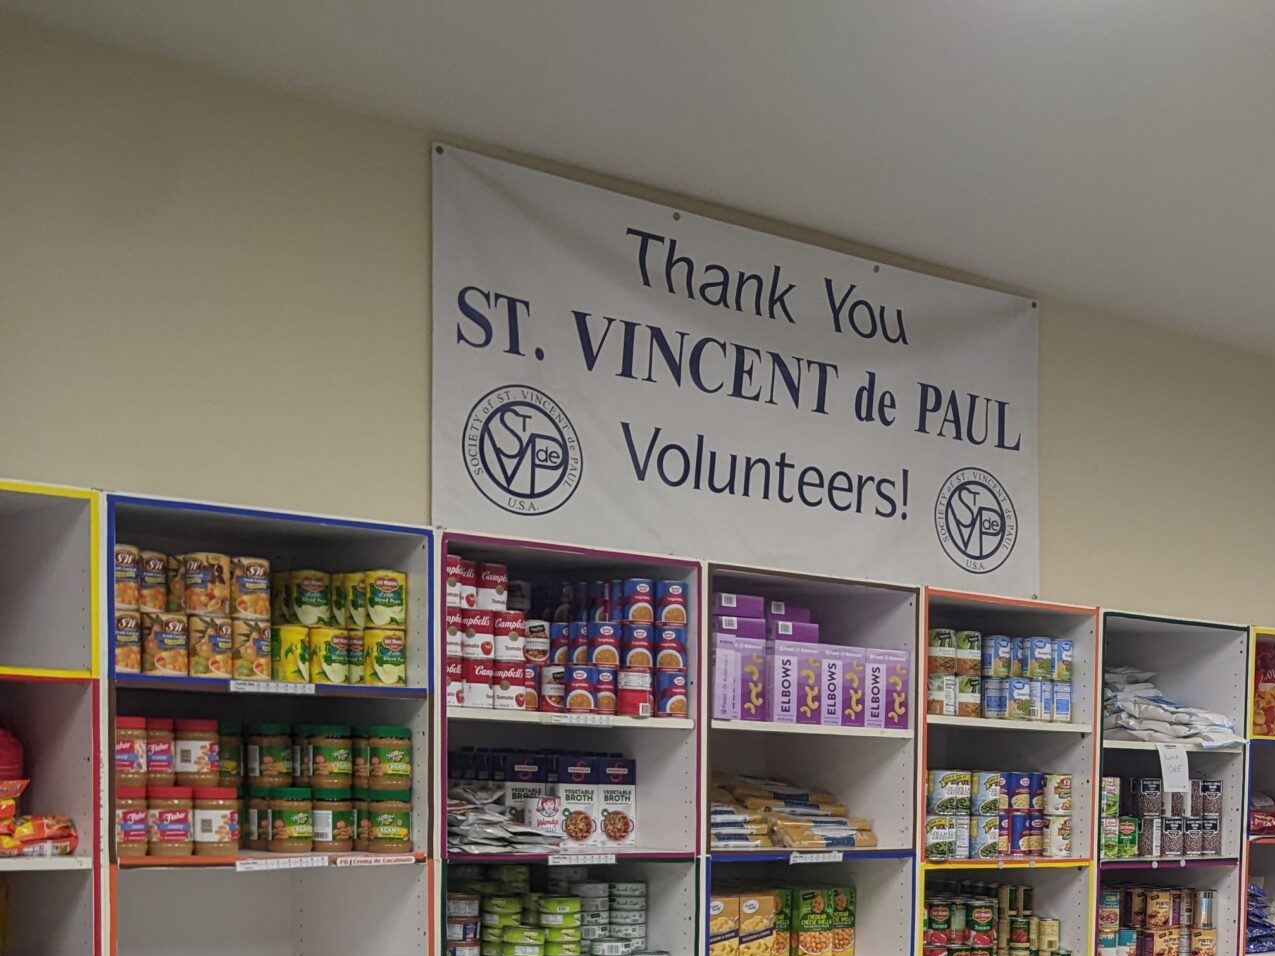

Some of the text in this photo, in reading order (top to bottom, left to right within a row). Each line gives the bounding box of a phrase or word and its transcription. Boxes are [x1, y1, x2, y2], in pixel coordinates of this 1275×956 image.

[626, 227, 909, 346] Thank You
[456, 285, 1022, 452] ST. VINCENT de PAUL
[468, 414, 484, 476] SOCIETY
[521, 390, 570, 430] VINCENT
[563, 457, 580, 488] PAUL
[620, 421, 910, 521] Volunteers!
[972, 472, 1008, 503] VINCENT
[507, 497, 541, 512] U.S.A.
[780, 658, 792, 713] ELBOWS
[826, 662, 837, 715] ELBOWS
[870, 666, 881, 719] ELBOWS
[565, 794, 593, 802] BROTH
